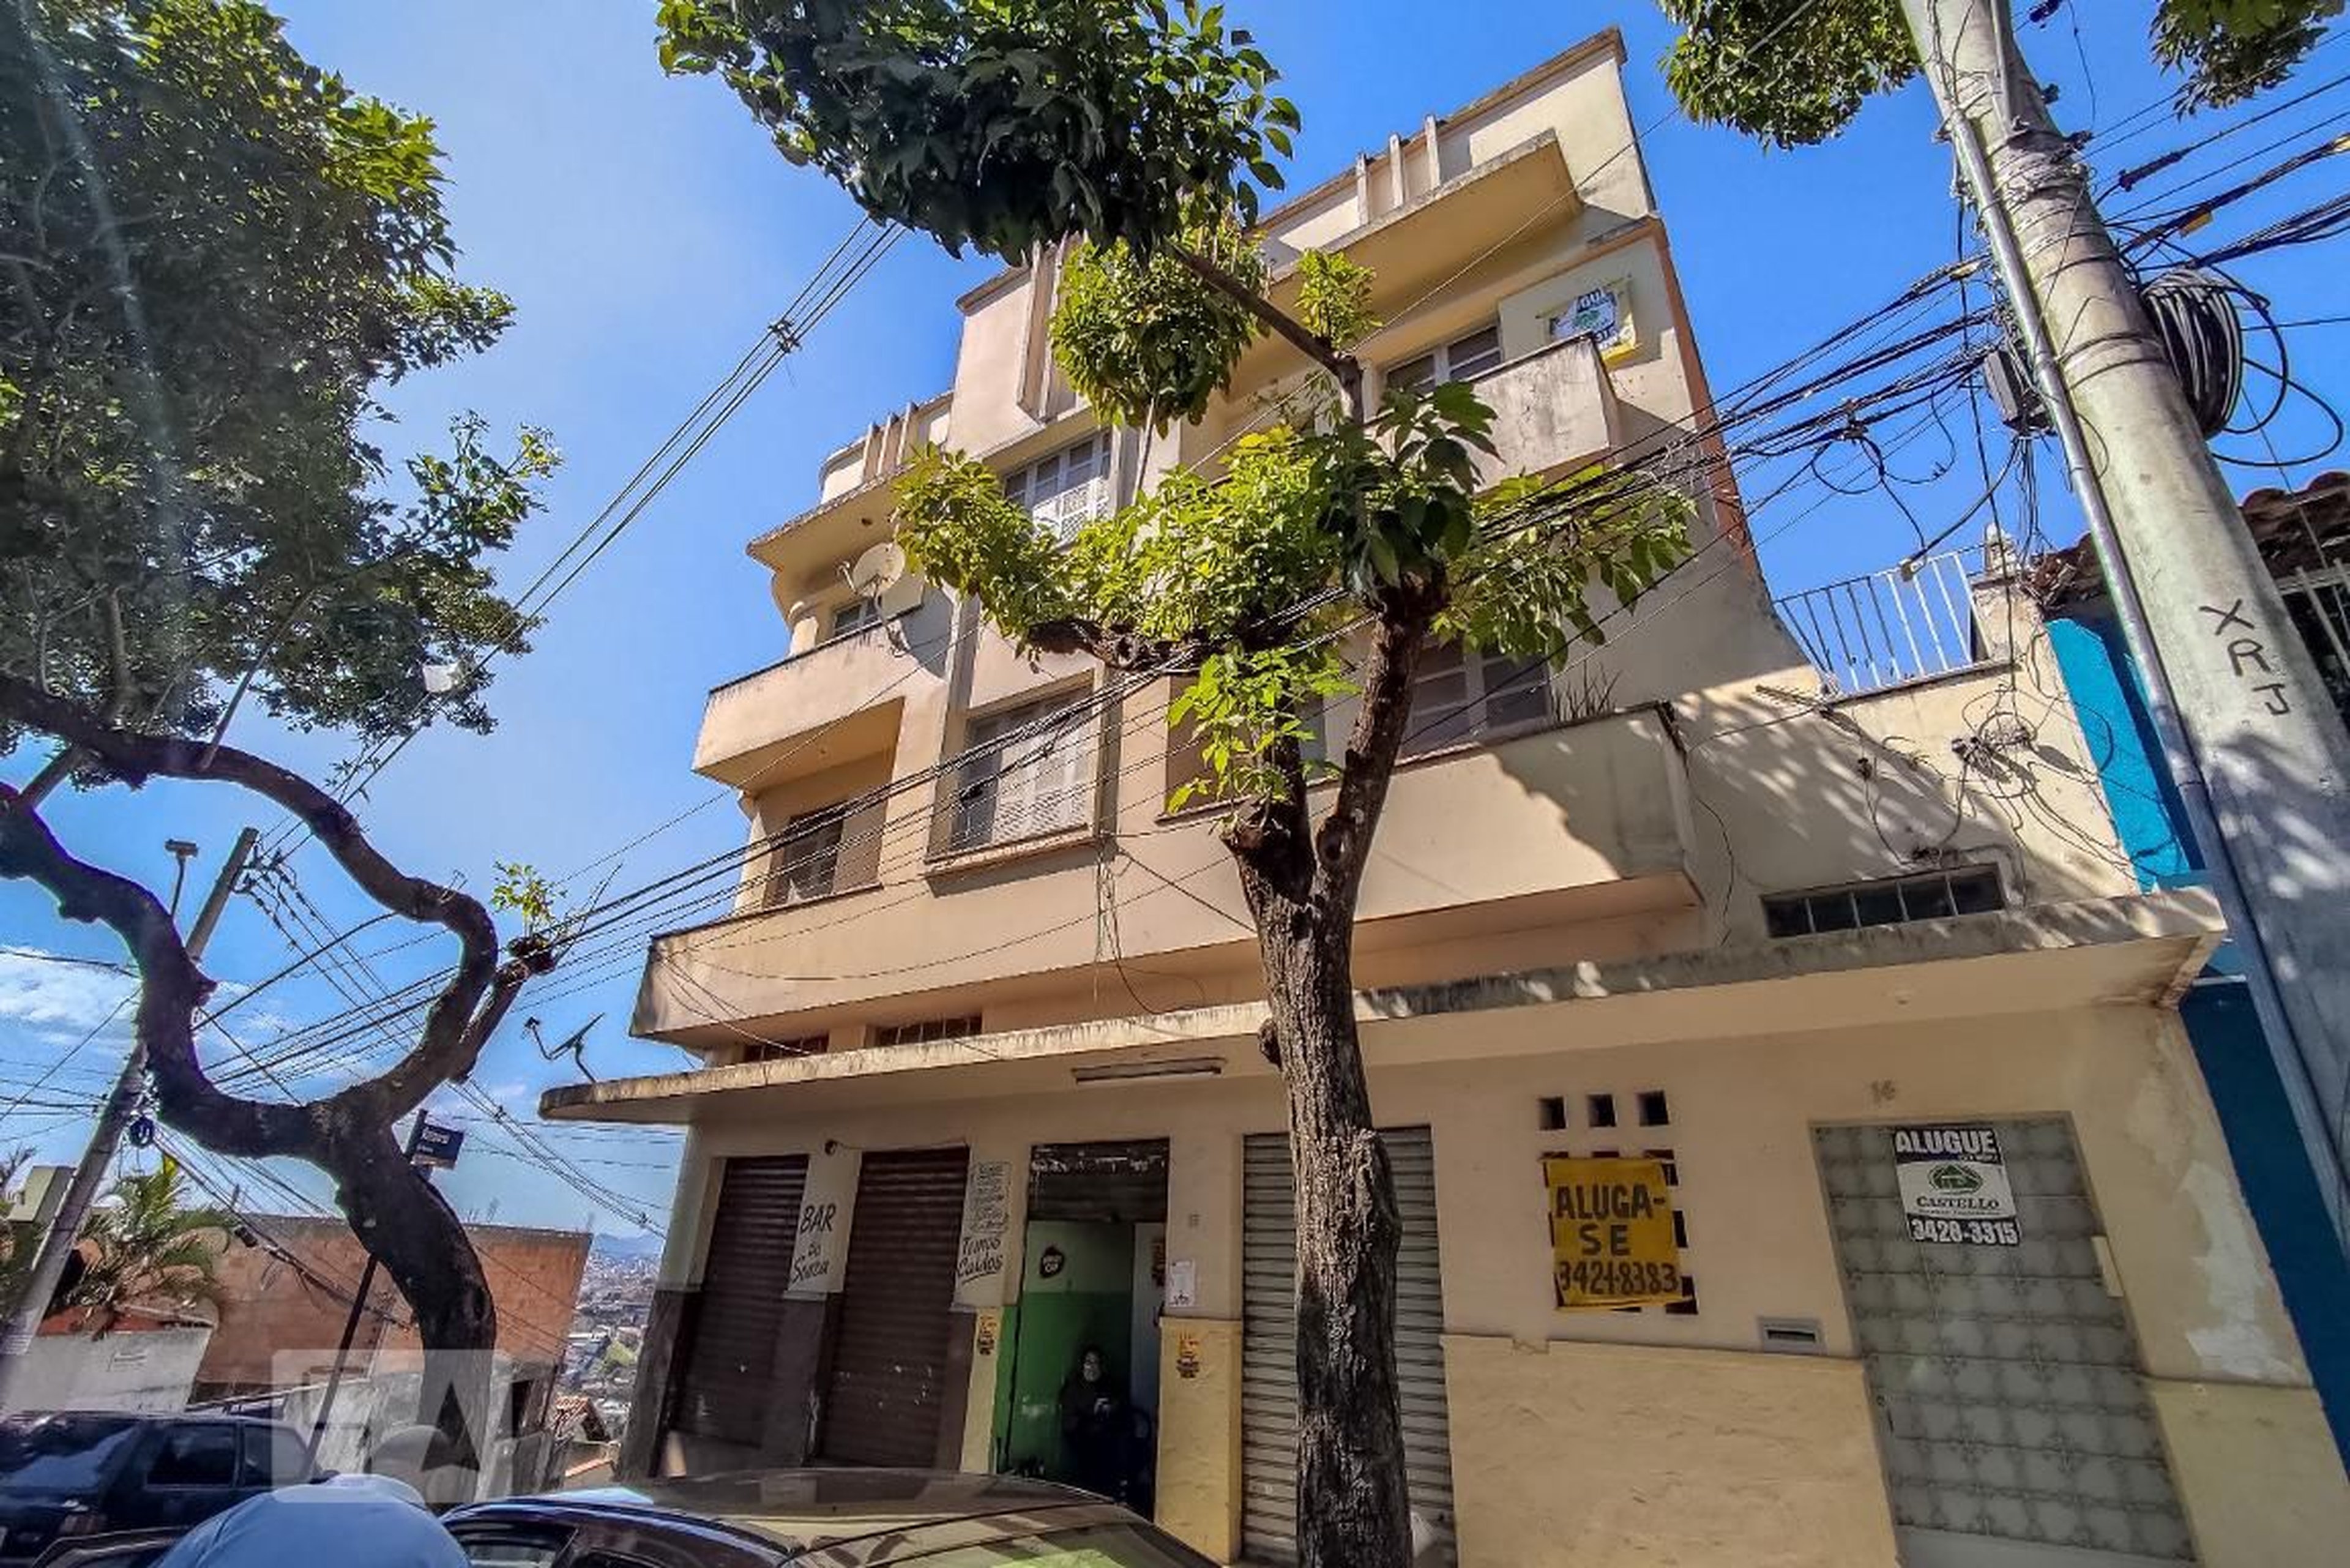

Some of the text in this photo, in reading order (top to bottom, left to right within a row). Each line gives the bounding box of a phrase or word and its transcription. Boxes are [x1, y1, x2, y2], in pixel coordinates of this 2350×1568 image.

[1895, 1130, 1997, 1154] ALUGUE
[1916, 1195, 2000, 1210] CASTELLO
[800, 1203, 837, 1234] BAR
